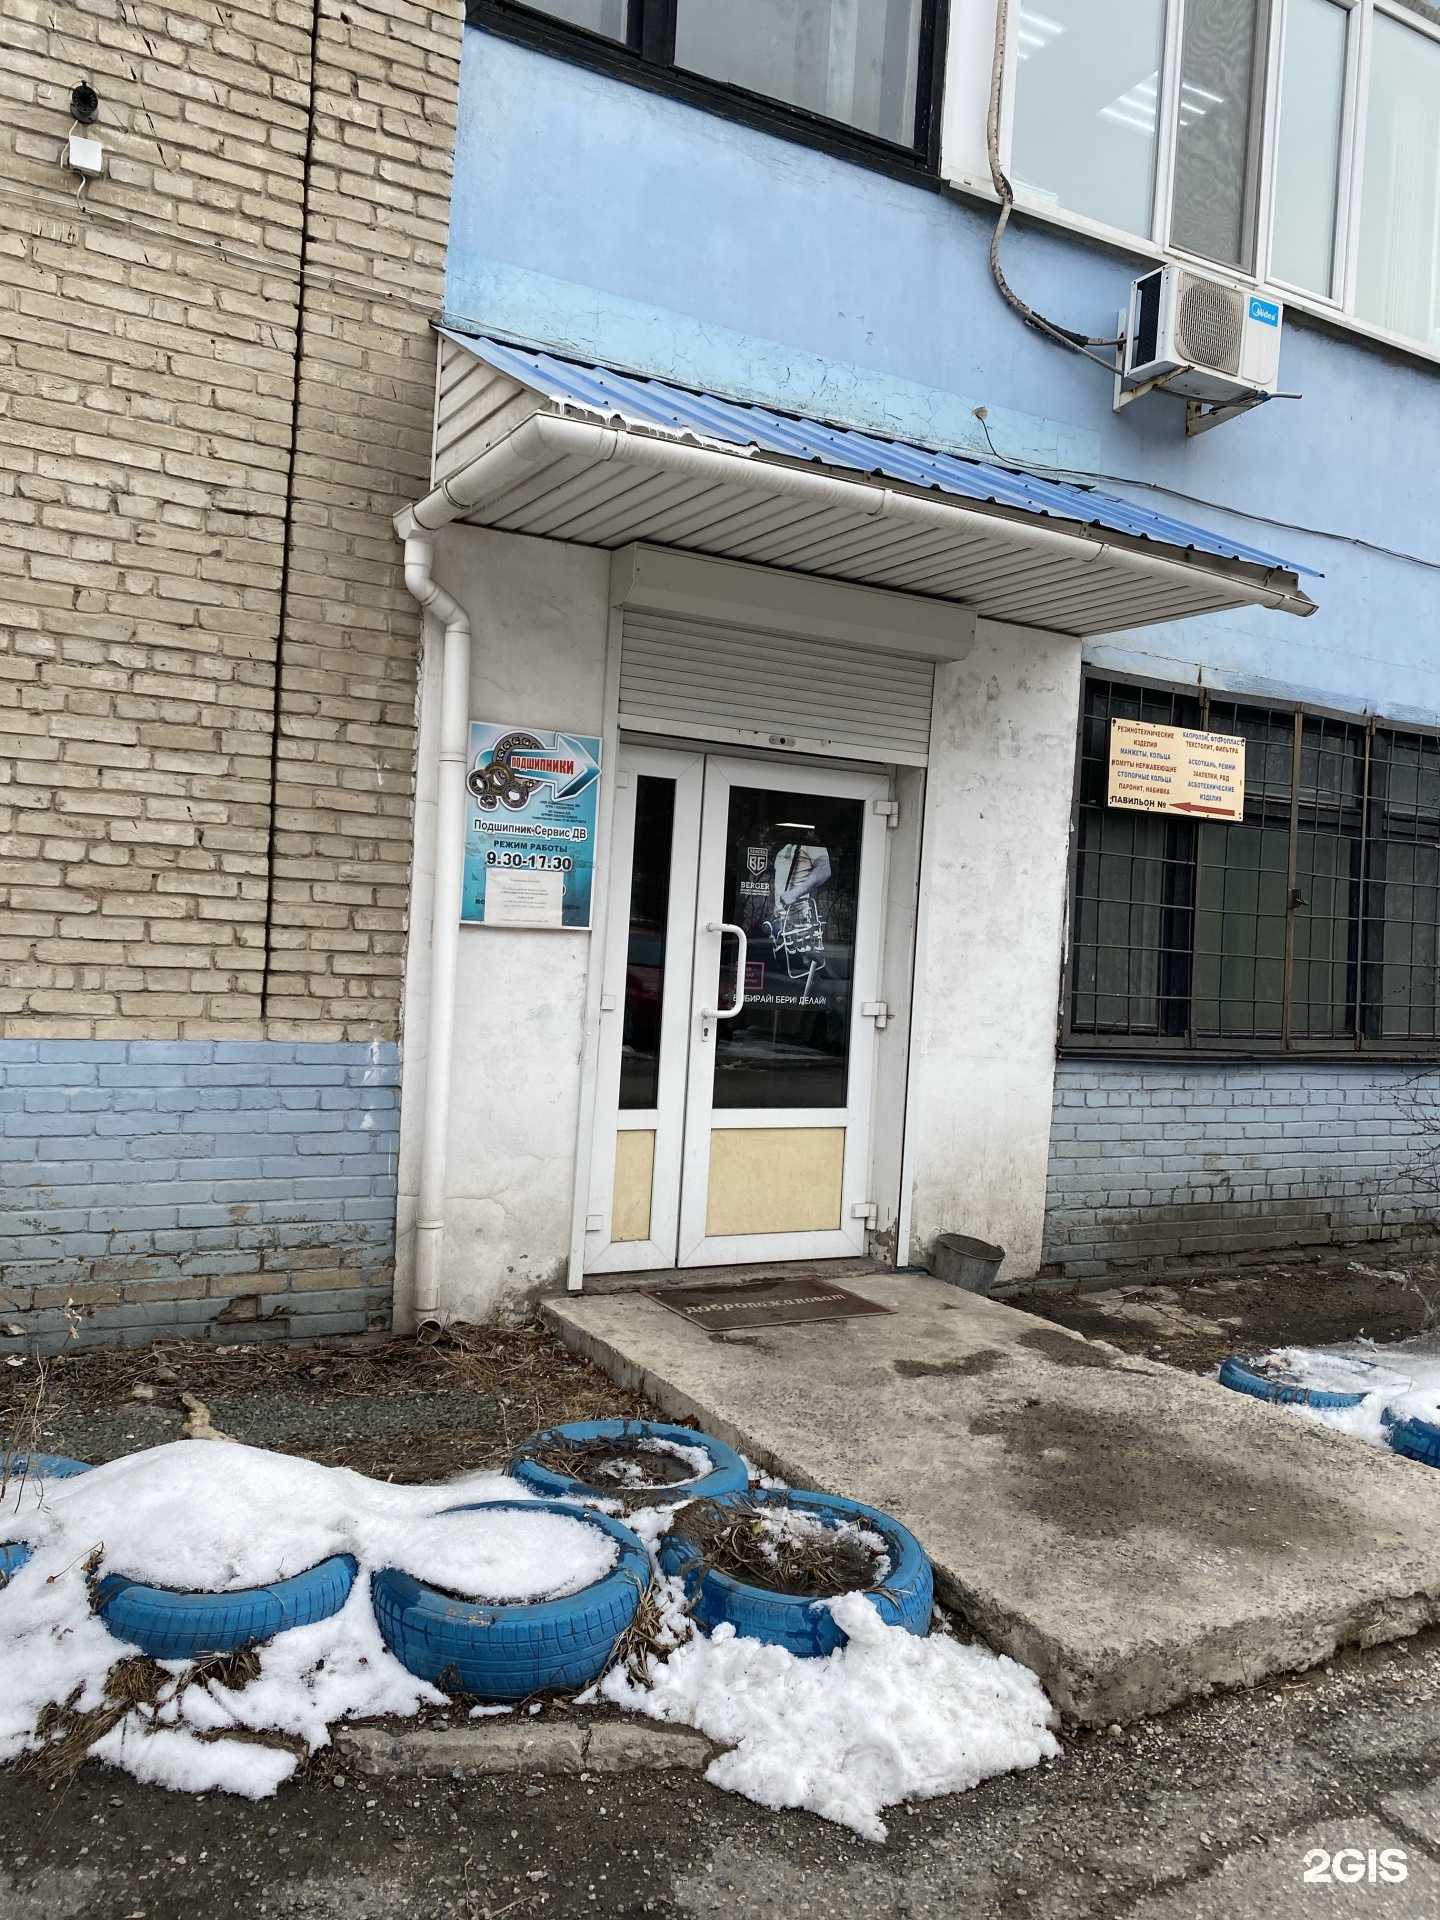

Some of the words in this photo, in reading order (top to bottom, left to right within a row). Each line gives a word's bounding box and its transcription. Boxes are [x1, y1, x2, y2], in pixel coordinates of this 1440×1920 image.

[1253, 303, 1276, 320] Midea
[1117, 725, 1175, 739] РЕЗИНОТЕХНИЧЕСКИЕ
[1133, 739, 1158, 748] ИЗДЕЛИЯ
[1120, 747, 1149, 758] МАНЖЕТЫ,
[511, 756, 574, 775] ПОДШИПНИКИ
[1135, 762, 1177, 773] НЕРЖАВЕЮЩИЕ
[1117, 770, 1150, 781] СТОПОРНЫЕ
[1150, 775, 1172, 783] КОЛЬЦА
[1118, 783, 1145, 793] ПАРОНИТ,
[1111, 795, 1155, 808] ПАВИЛЬОН
[1157, 800, 1167, 808] №
[474, 819, 570, 838] Подшипник-Сервис
[572, 828, 587, 841] ДВ
[494, 840, 528, 850] РЕЖИМ
[529, 843, 568, 853] РАБОТЫ
[486, 851, 572, 870] 9.30-17.30
[740, 881, 770, 890] BERGER
[732, 993, 774, 1003] ВБИРАЙ!
